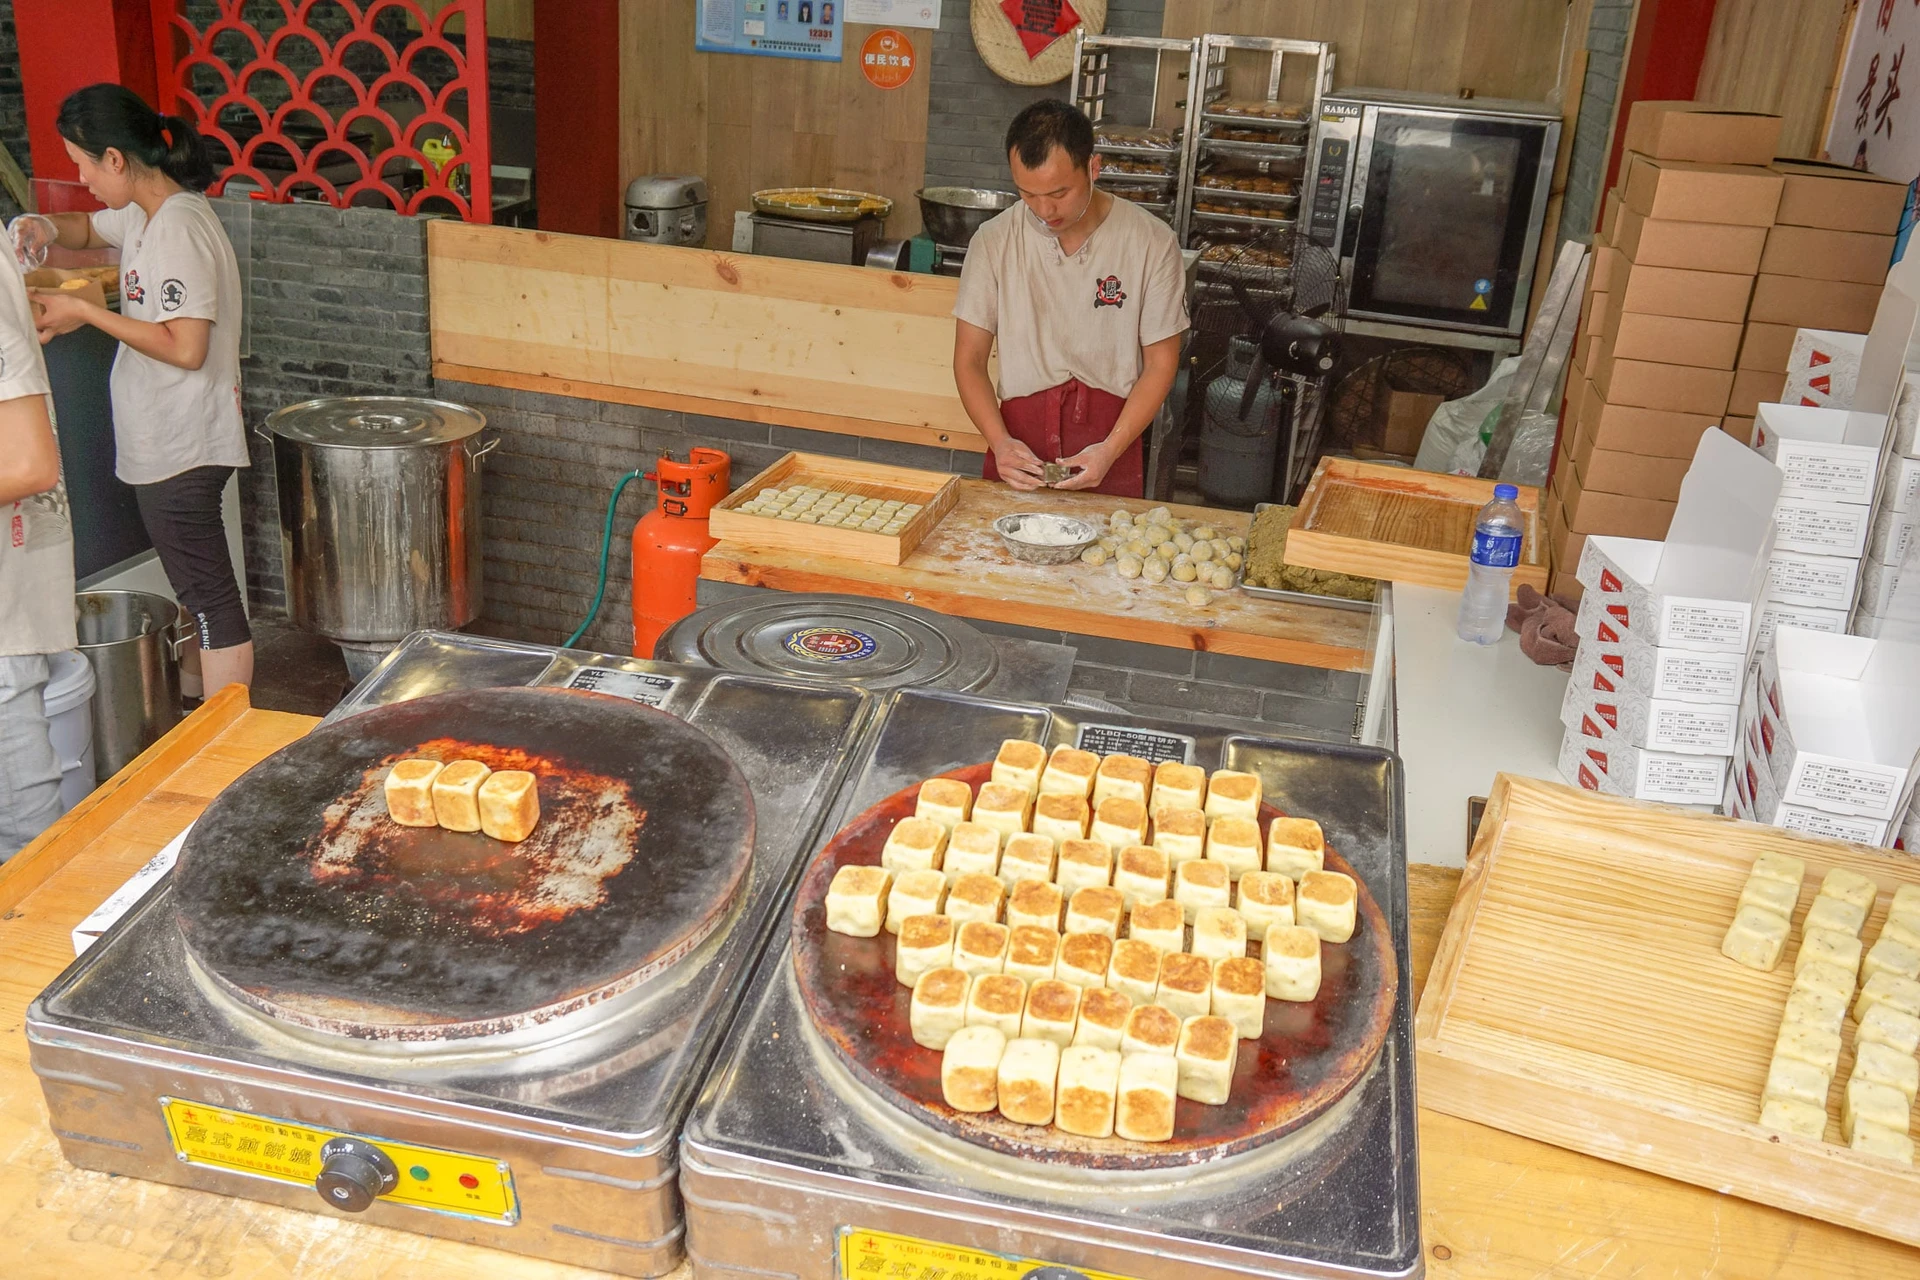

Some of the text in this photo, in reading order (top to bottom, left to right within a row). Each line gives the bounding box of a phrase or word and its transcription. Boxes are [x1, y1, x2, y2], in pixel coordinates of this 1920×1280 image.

[809, 29, 832, 38] 12331
[865, 53, 911, 67] 便民饮食
[1324, 105, 1358, 115] SAMAG
